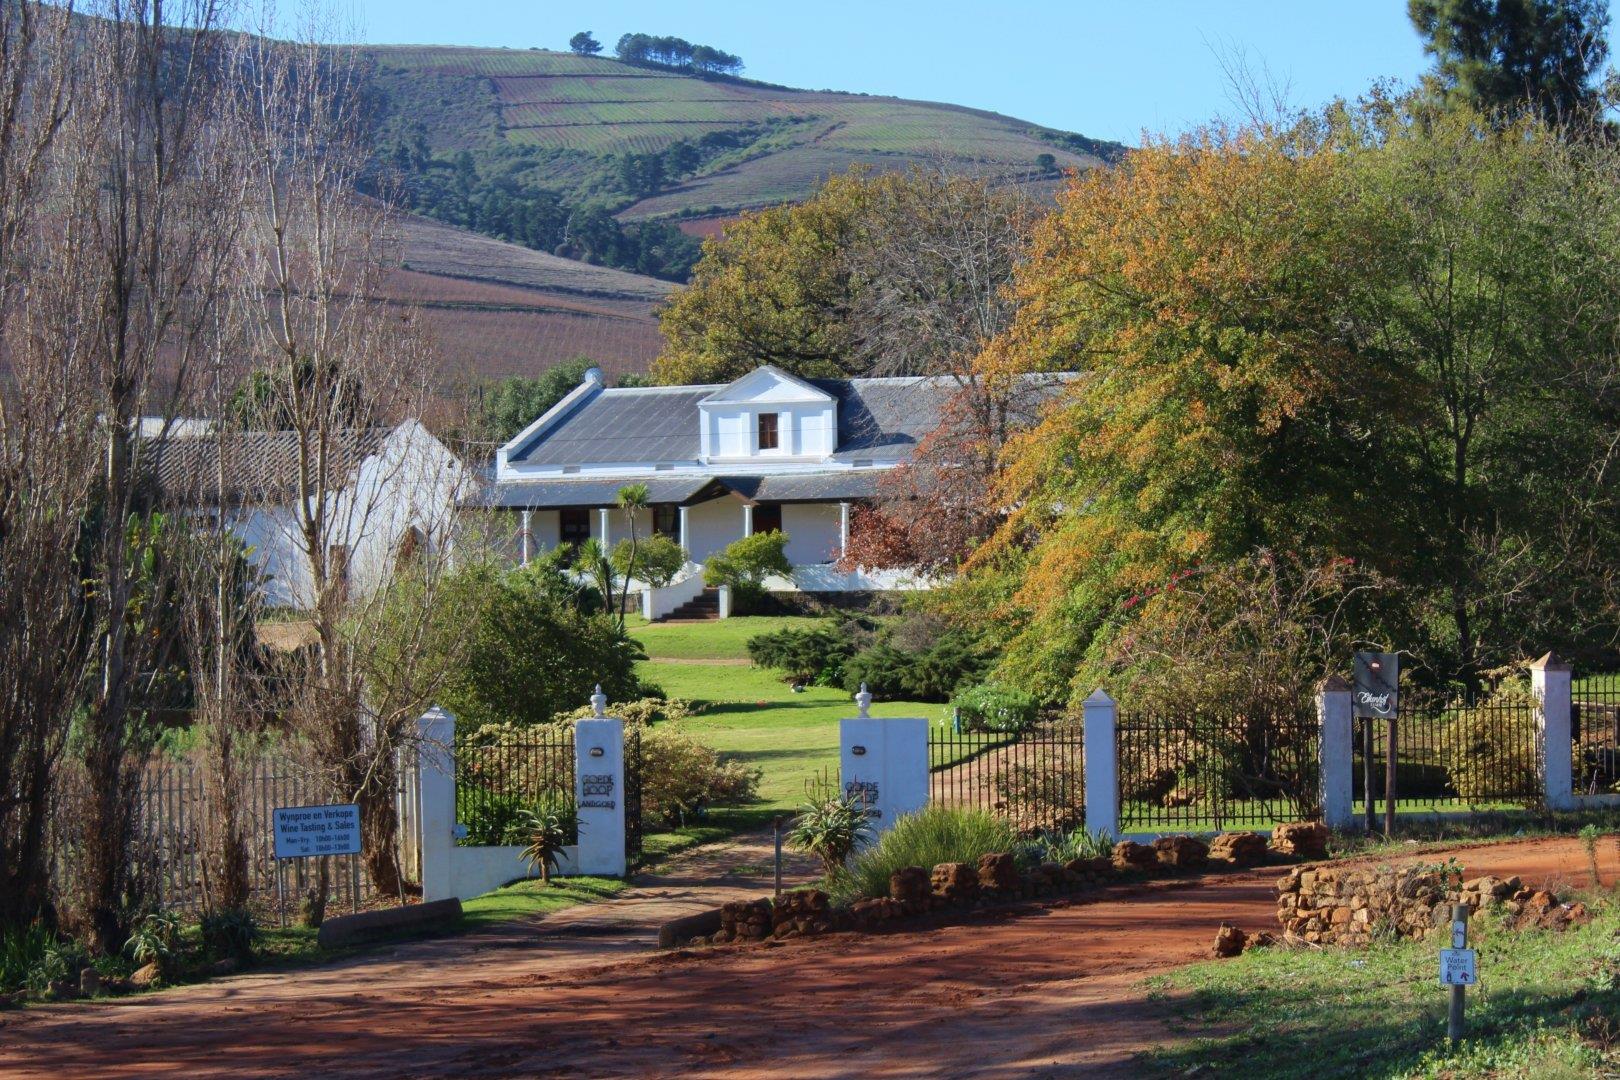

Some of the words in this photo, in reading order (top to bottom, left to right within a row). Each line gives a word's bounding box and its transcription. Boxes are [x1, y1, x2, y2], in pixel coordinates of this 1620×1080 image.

[582, 774, 614, 785] GOEDE
[578, 800, 615, 810] LANDGOED
[279, 812, 312, 823] Wynproe
[313, 811, 323, 820] en
[324, 809, 354, 820] Verkope
[280, 824, 299, 833] Wine
[301, 822, 326, 833] Tasting
[327, 822, 333, 830] &
[335, 820, 355, 830] Sales
